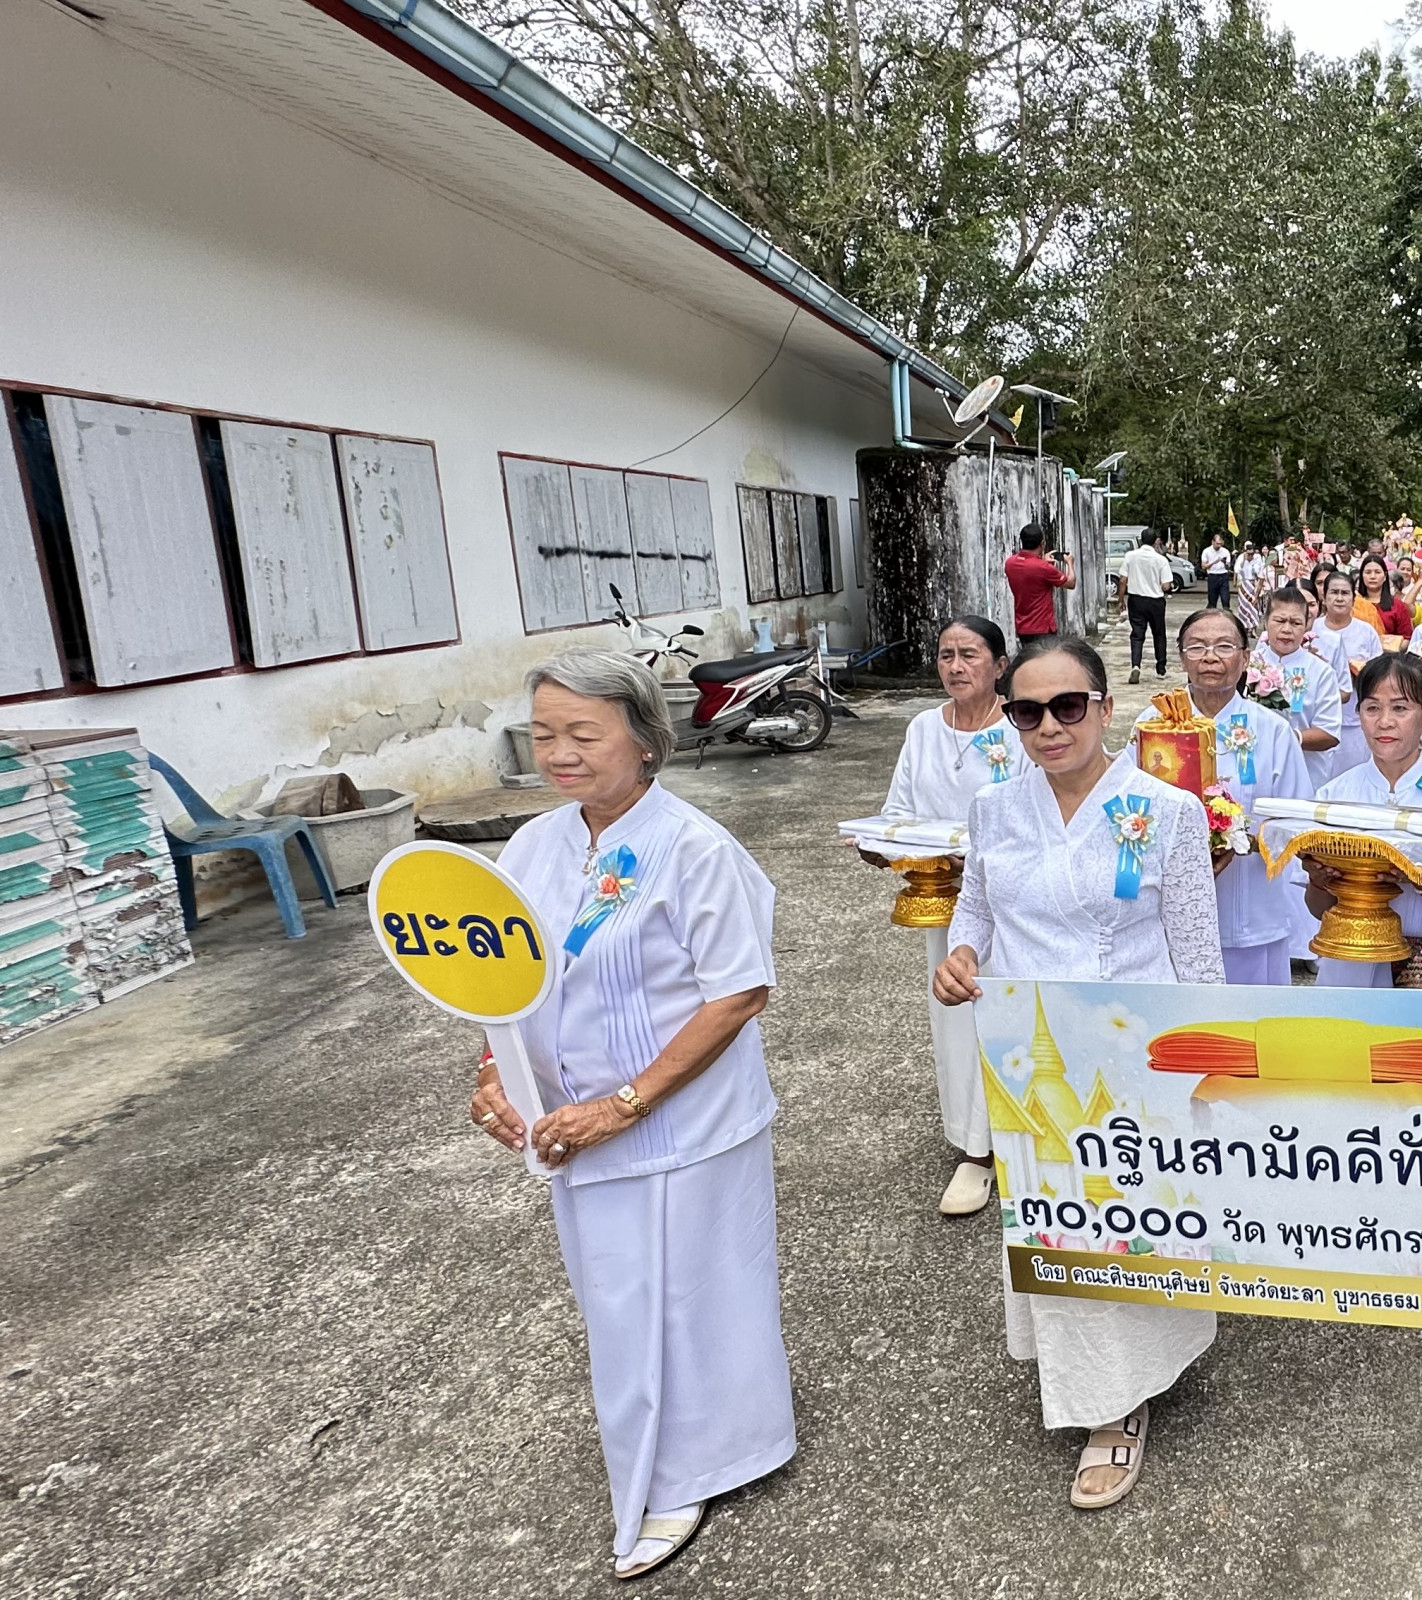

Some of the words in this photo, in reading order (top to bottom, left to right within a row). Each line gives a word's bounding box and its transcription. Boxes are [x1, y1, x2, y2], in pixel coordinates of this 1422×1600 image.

[383, 912, 543, 961] ยะลา
[1021, 1197, 1208, 1240] ๓๐,๐๐๐
[1222, 1207, 1266, 1244] วัด
[1033, 1257, 1065, 1281] โดย
[1073, 1264, 1211, 1298] คณะศิษยานุศิษย์
[1218, 1275, 1324, 1303] จังหวัดยะลา
